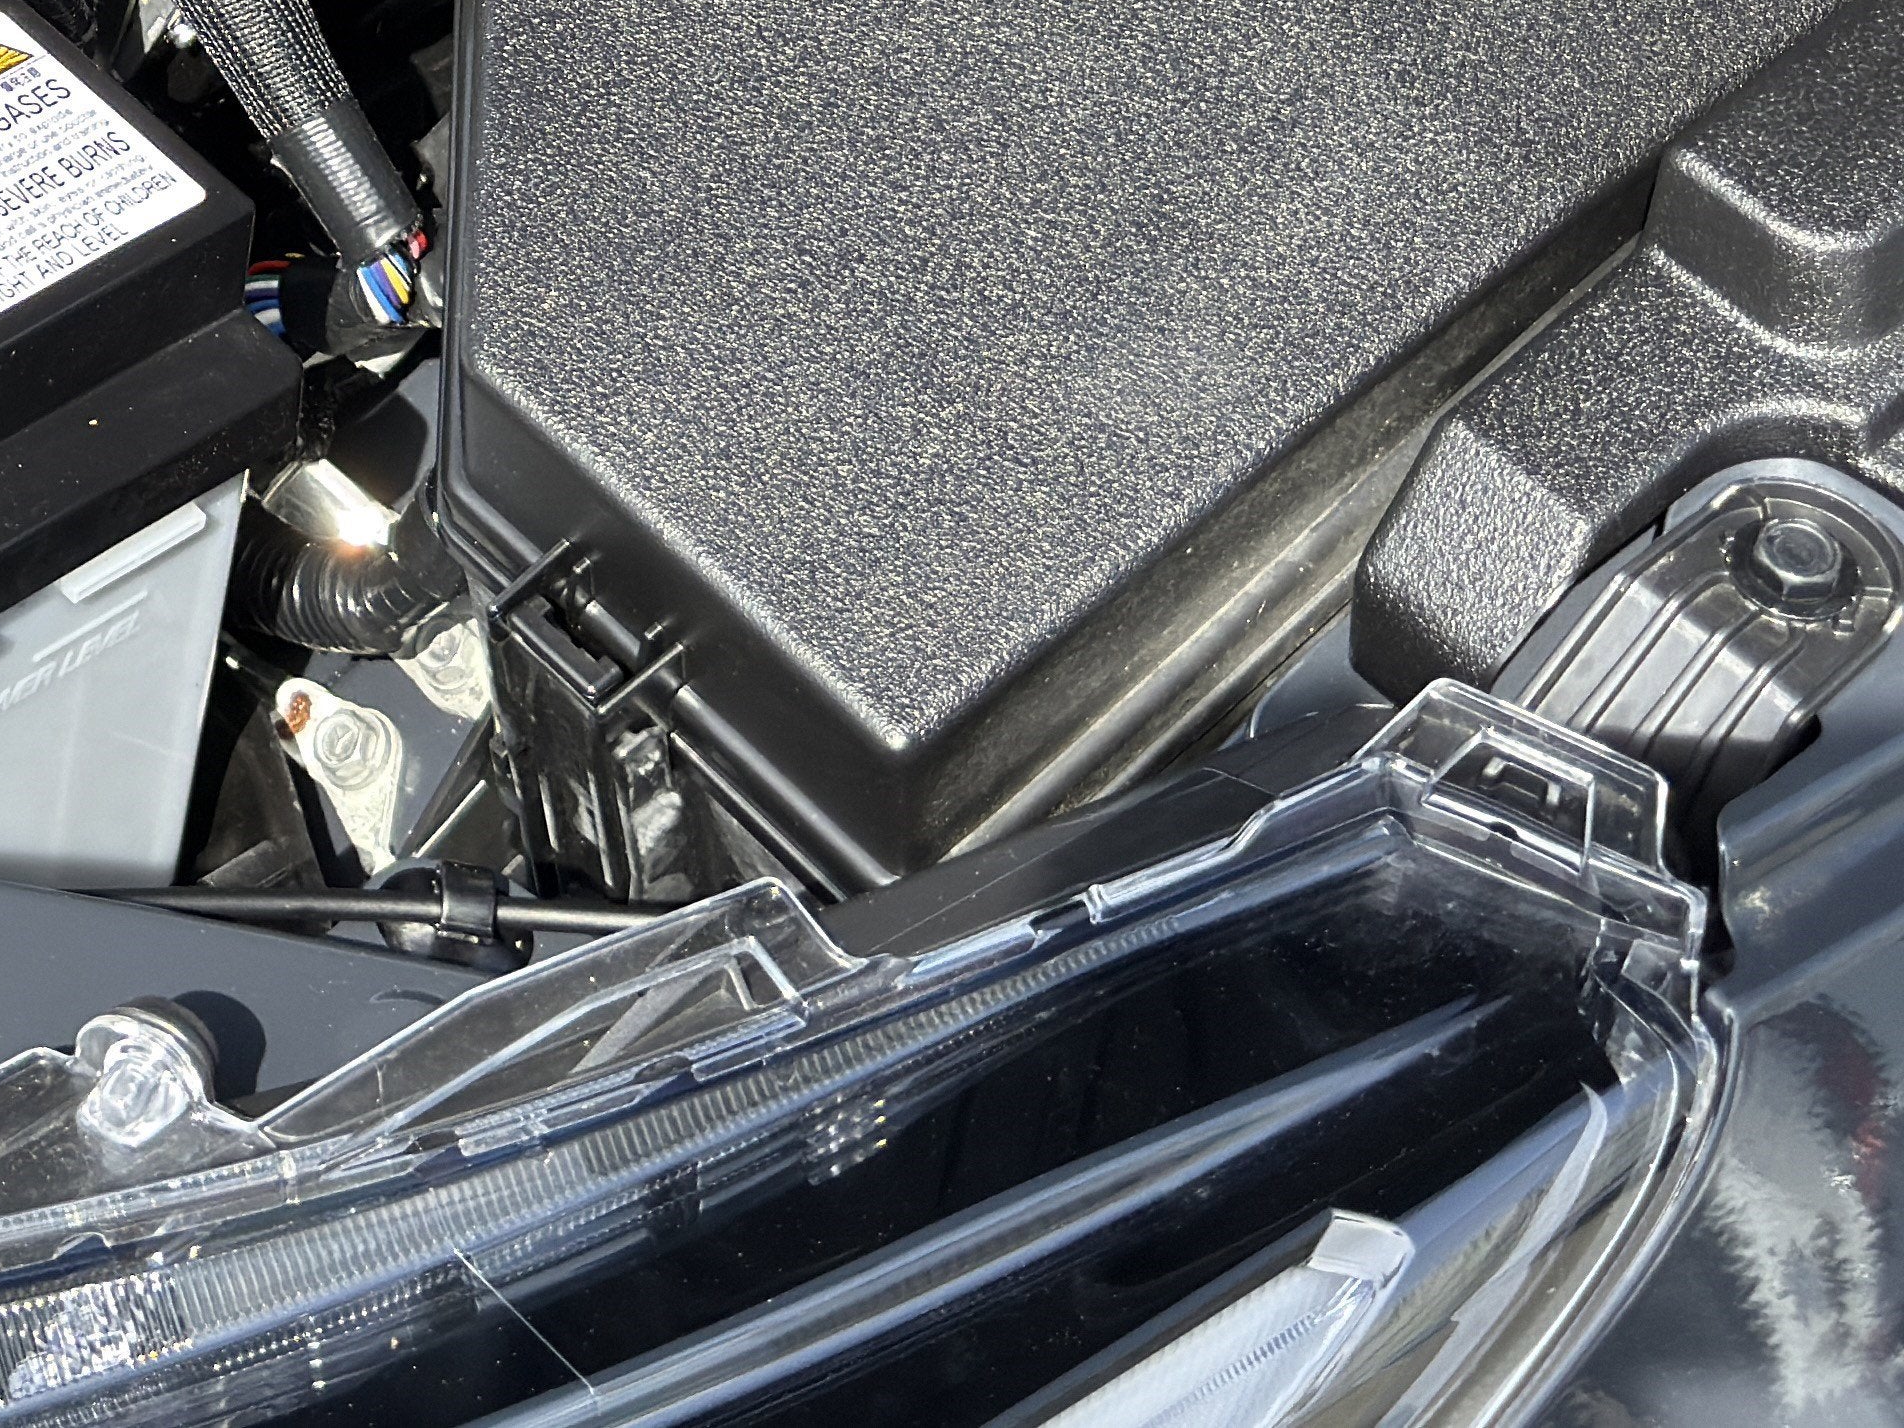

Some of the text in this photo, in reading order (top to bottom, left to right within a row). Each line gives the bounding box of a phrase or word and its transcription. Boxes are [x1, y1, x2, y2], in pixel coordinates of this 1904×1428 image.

[57, 131, 130, 178] BURNS
[1, 245, 37, 264] THE
[31, 222, 82, 253] REACH
[82, 207, 104, 226] OF
[104, 172, 176, 215] CHILDREN
[36, 251, 73, 278] AND
[74, 223, 128, 256] LEVEL
